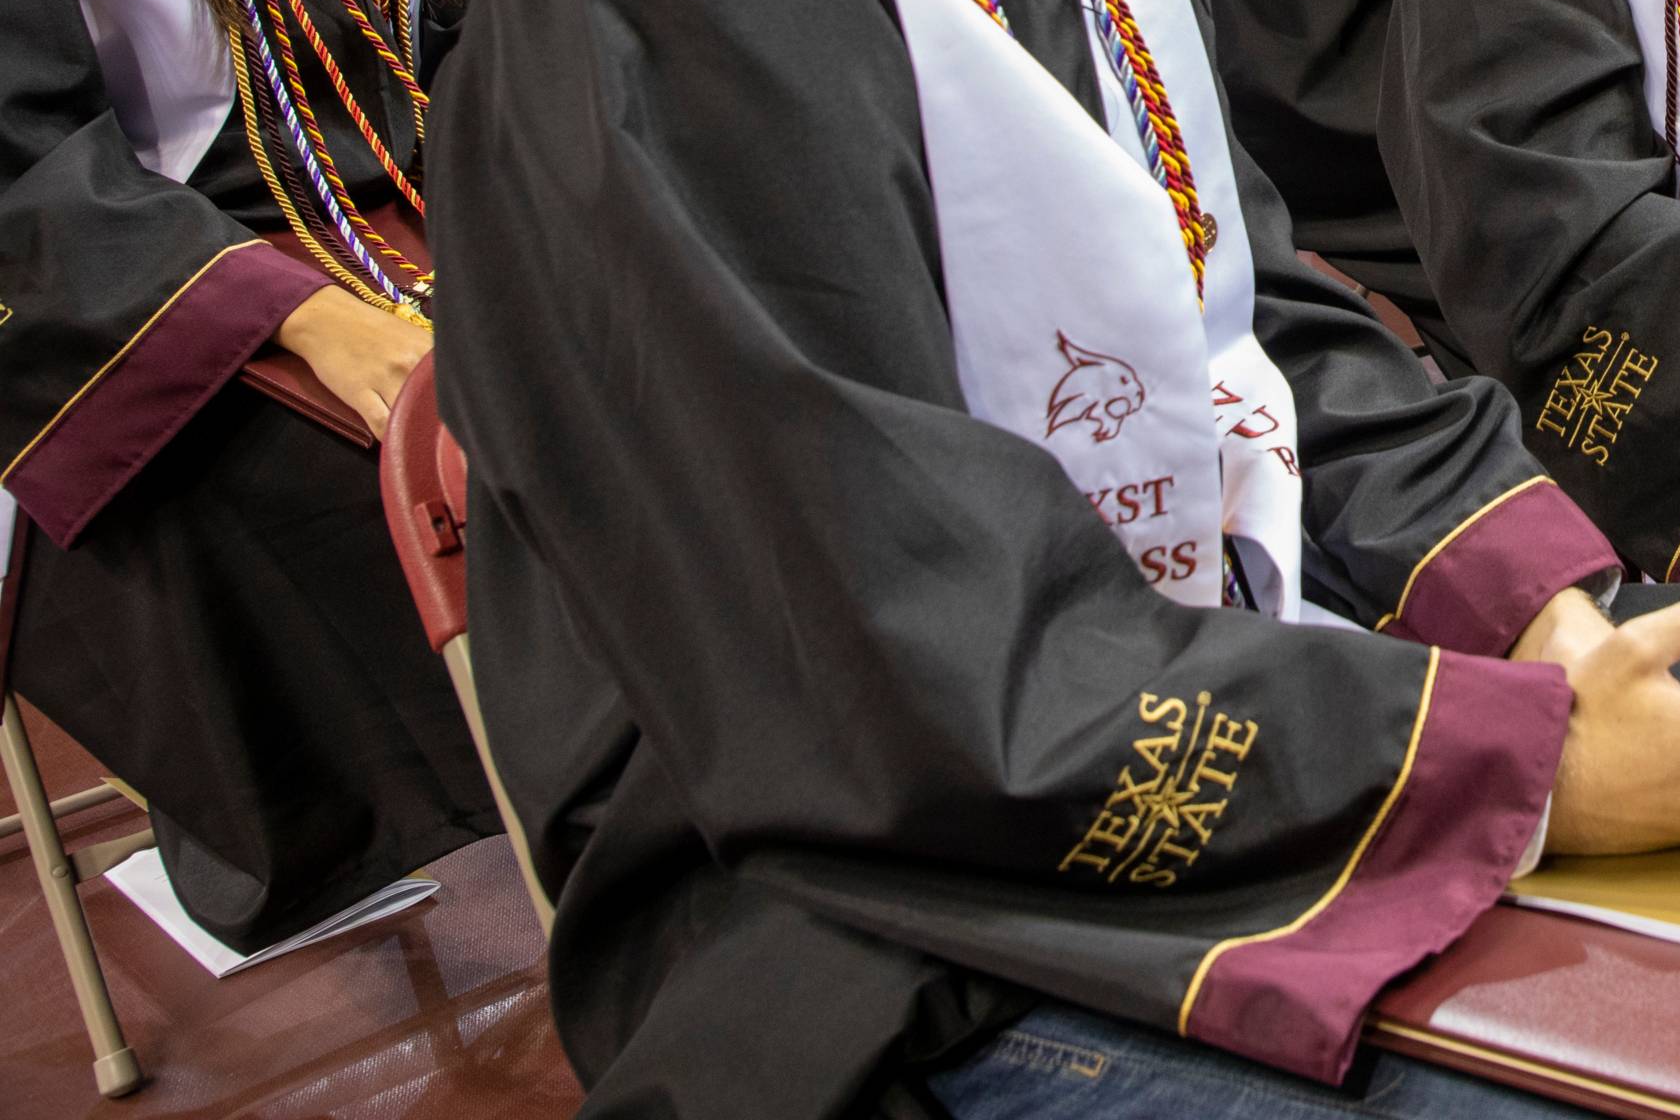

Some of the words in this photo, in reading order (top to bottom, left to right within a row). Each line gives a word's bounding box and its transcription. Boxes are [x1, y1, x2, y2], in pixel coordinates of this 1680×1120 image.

[1537, 326, 1612, 437] TEXAS
[1581, 348, 1658, 466] STATE
[1085, 474, 1174, 527] XST
[1057, 691, 1187, 872] TEXAS
[1130, 712, 1258, 886] STATE
